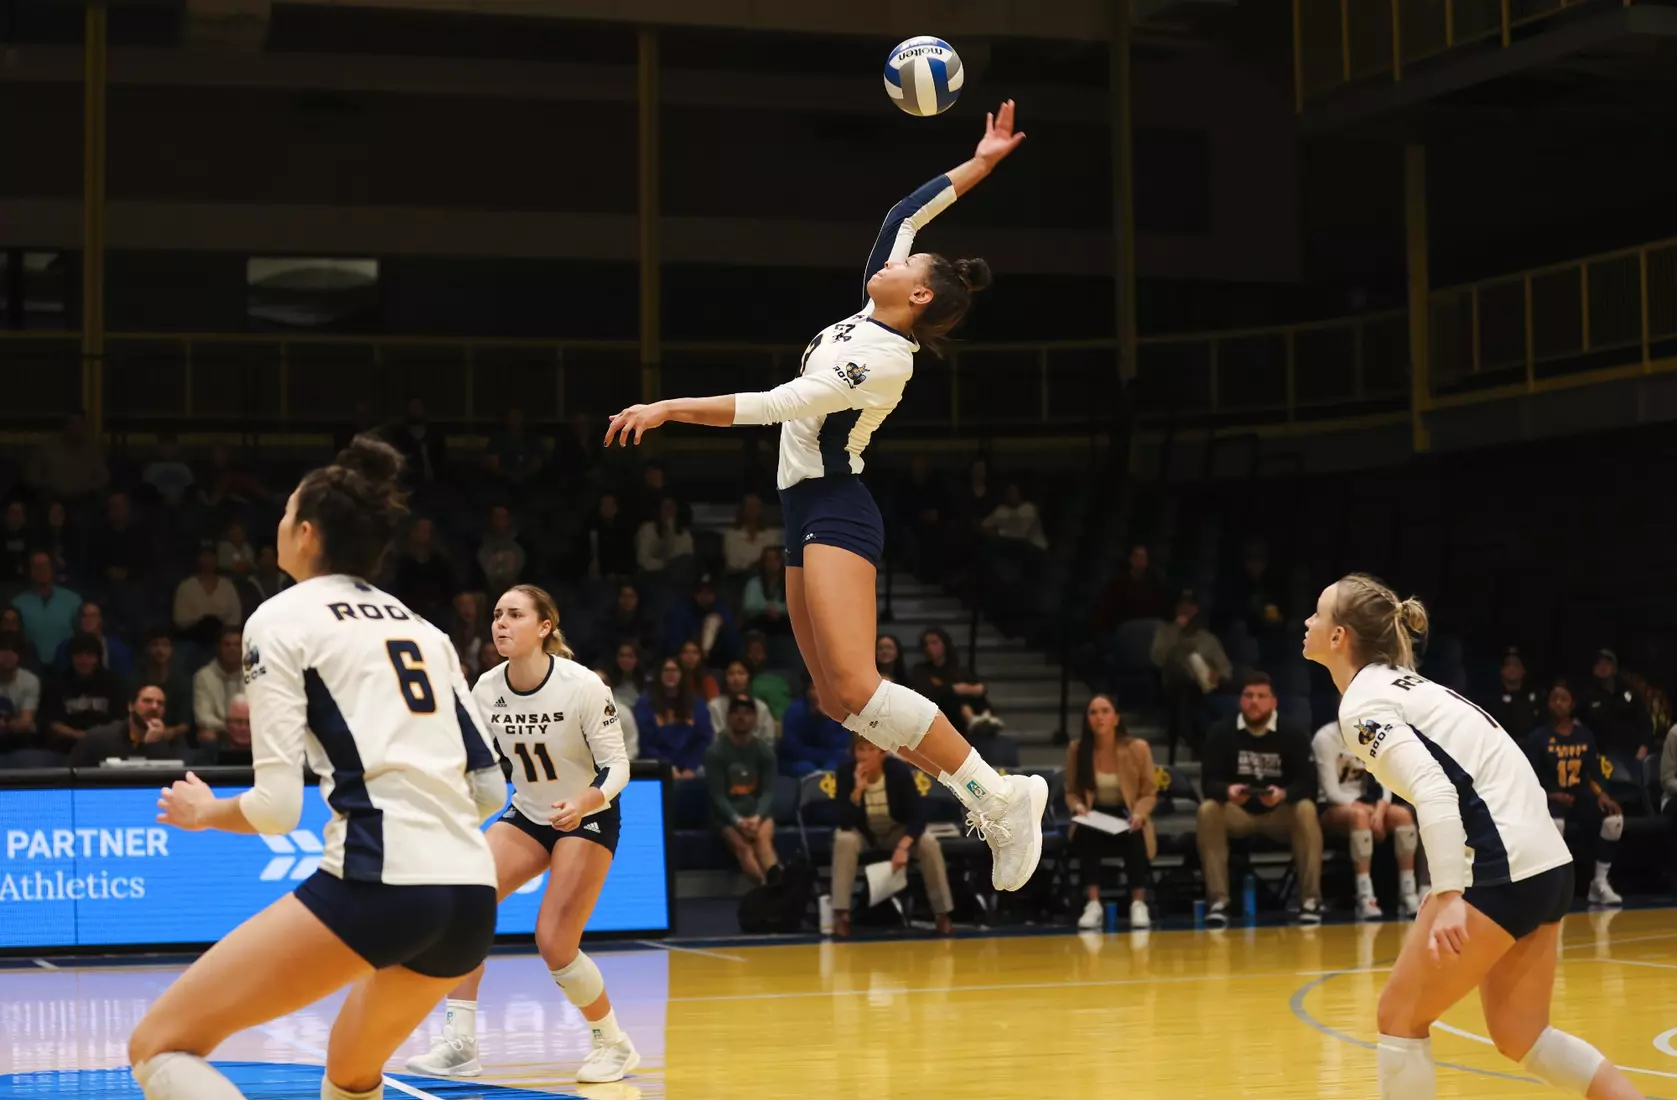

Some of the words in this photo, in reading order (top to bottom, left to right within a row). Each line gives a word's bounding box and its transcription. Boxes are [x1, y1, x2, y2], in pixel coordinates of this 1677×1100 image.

[898, 47, 943, 61] molten
[327, 602, 416, 622] ROO
[386, 639, 437, 714] 6
[491, 711, 565, 724] KANSAS
[505, 724, 549, 735] CITY
[1369, 723, 1393, 758] ROOS
[514, 742, 559, 783] 11
[7, 828, 169, 859] PARTNER
[0, 870, 146, 901] Athletics
